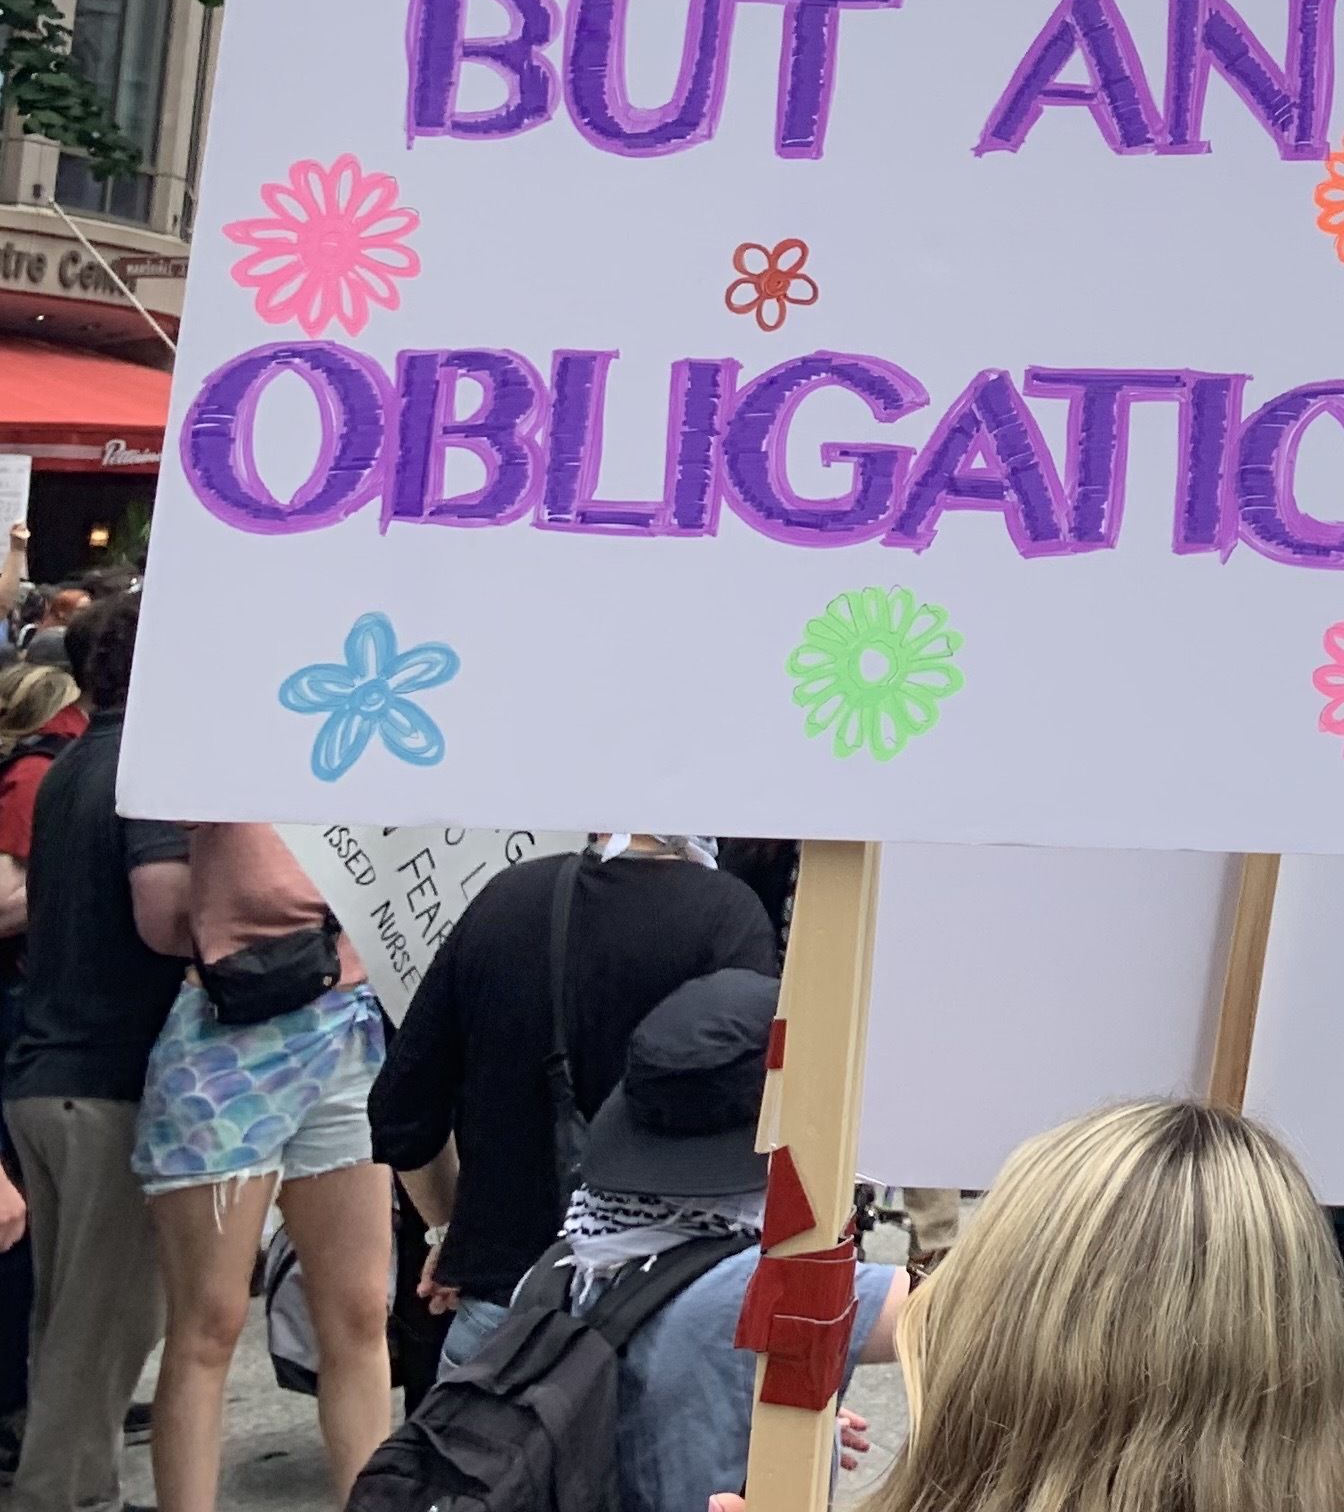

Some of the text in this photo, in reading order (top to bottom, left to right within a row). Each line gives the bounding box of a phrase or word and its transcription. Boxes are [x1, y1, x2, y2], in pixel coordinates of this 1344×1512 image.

[0, 241, 48, 284] tre
[322, 824, 424, 994] ISSED NURSE
